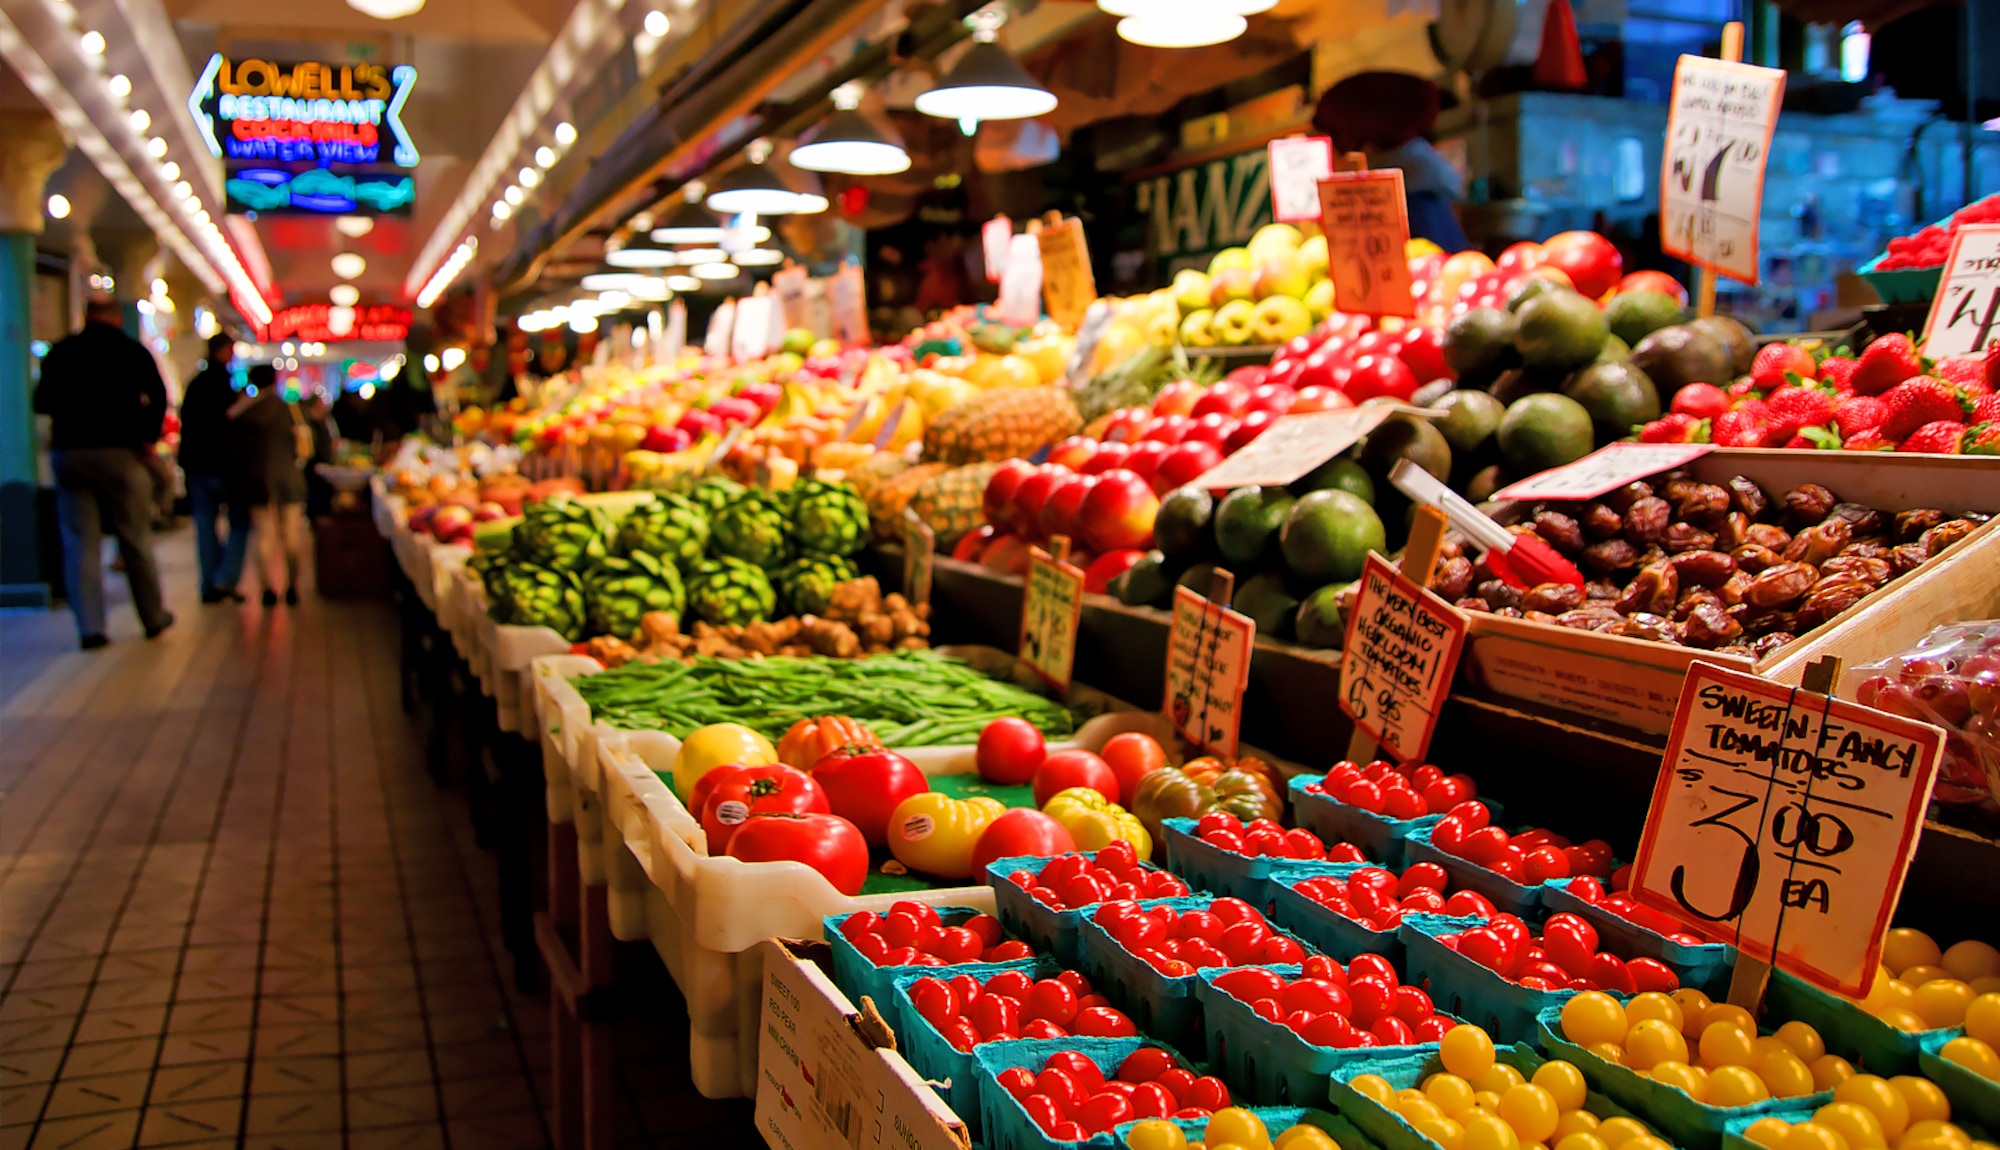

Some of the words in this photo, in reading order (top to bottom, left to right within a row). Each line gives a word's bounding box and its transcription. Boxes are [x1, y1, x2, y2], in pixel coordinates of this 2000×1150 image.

[219, 57, 391, 101] LOWELL'S
[219, 94, 386, 126] RESTAURANT
[232, 117, 378, 146] COCKTAILS
[1368, 573, 1389, 597] THE
[1387, 588, 1415, 620] VERY
[1416, 610, 1451, 641] BEST
[1374, 606, 1433, 652] ORGANIC
[1705, 724, 1866, 791] TOMATOES
[1670, 785, 1760, 922] 3
[1772, 801, 1855, 857] 00
[1780, 878, 1830, 914] EA
[770, 972, 791, 1001] SWEET
[769, 997, 781, 1018] RED
[781, 1010, 797, 1036] PEAR
[894, 1114, 923, 1150] SUNGO
